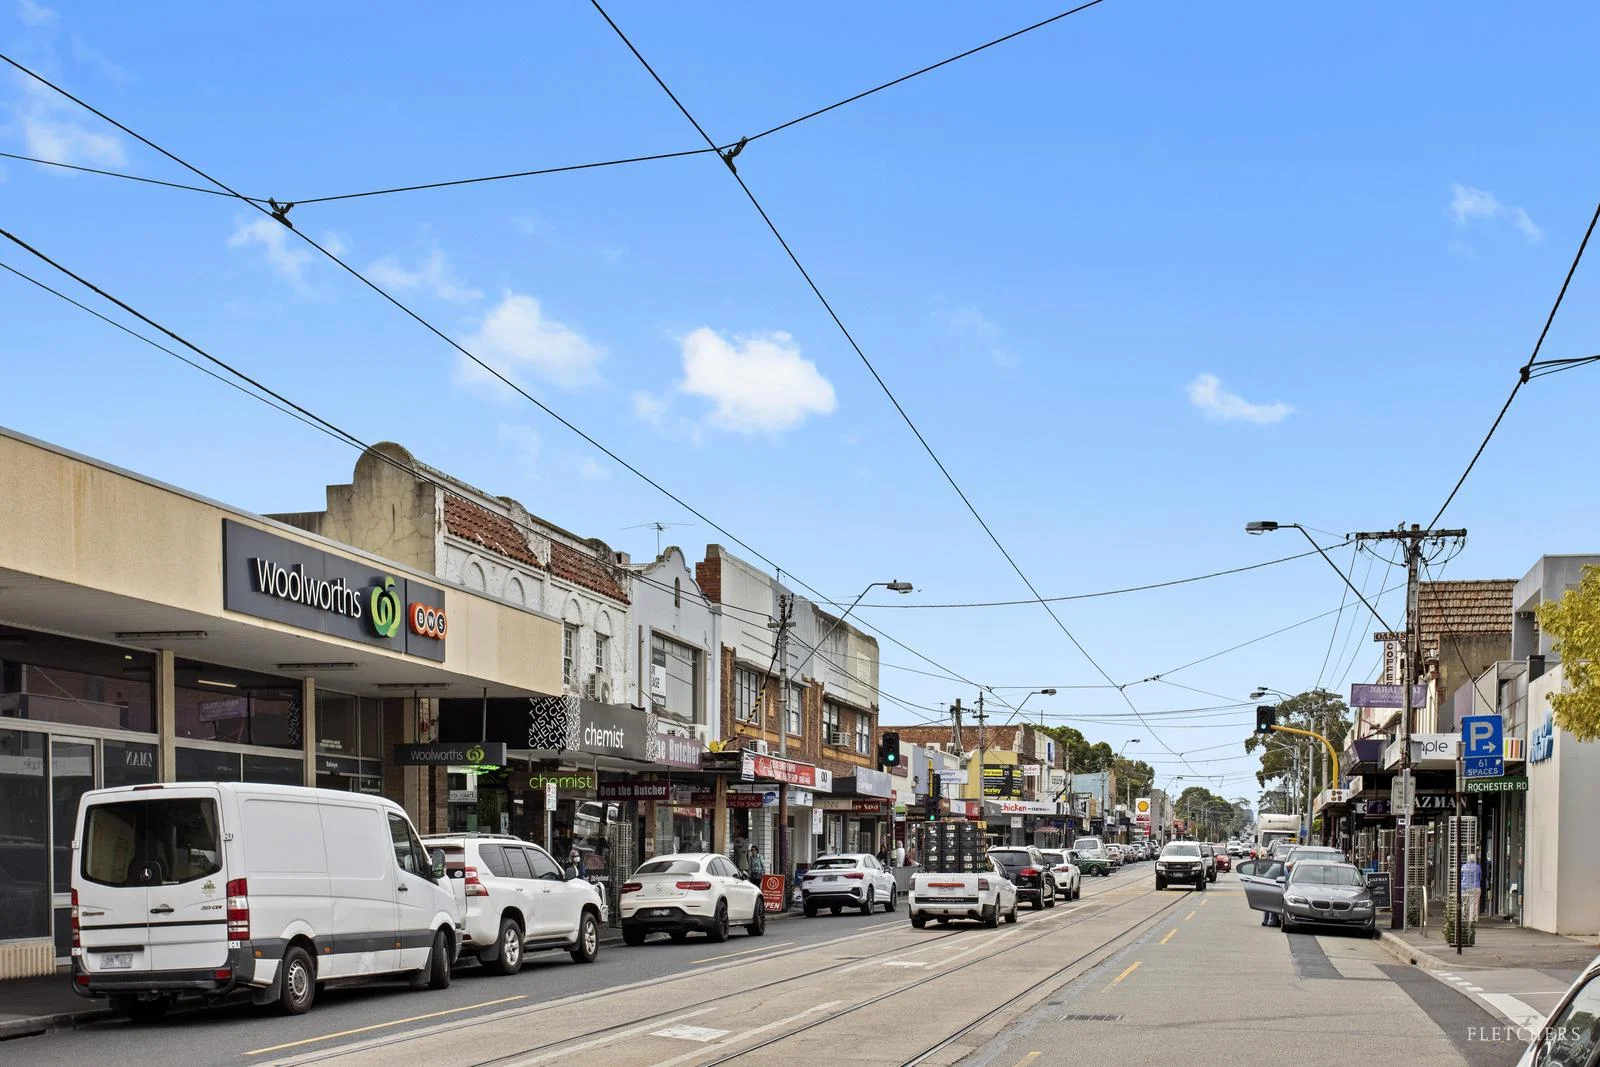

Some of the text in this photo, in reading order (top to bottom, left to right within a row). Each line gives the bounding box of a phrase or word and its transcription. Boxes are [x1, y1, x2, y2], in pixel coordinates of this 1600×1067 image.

[417, 611, 444, 631] BWS
[584, 721, 625, 749] chemist
[669, 739, 700, 765] Butcher
[1478, 759, 1488, 767] 61
[1467, 767, 1499, 776] SPACES
[634, 785, 667, 796] Butcher
[1467, 781, 1528, 792] ROCHESTER RD
[1413, 796, 1468, 809] AZMAN
